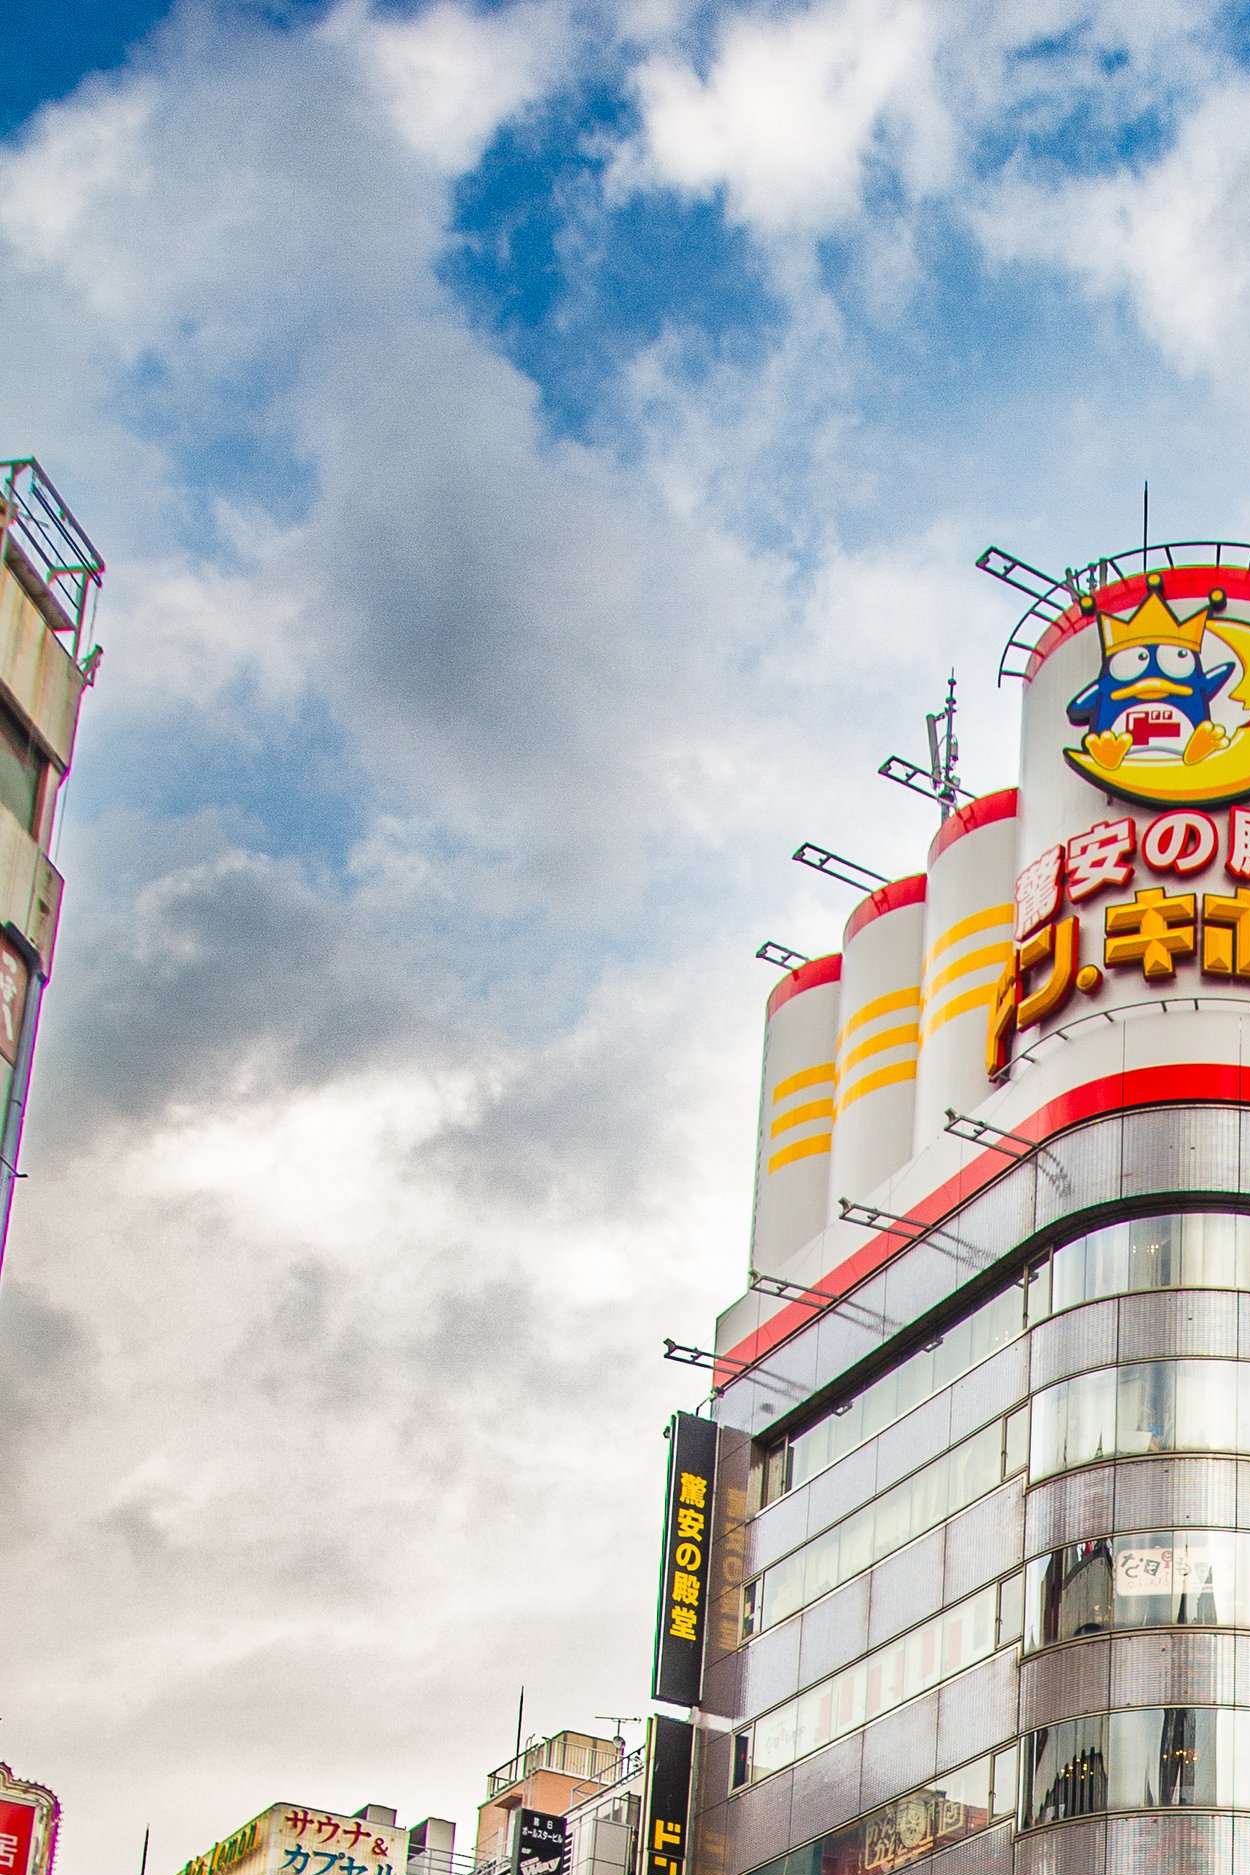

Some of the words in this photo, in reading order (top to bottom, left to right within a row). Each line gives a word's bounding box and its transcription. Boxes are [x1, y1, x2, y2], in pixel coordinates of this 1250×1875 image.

[669, 1471, 708, 1642] 驚安の殿堂
[284, 1809, 373, 1850] サウナ
[371, 1836, 390, 1858] &
